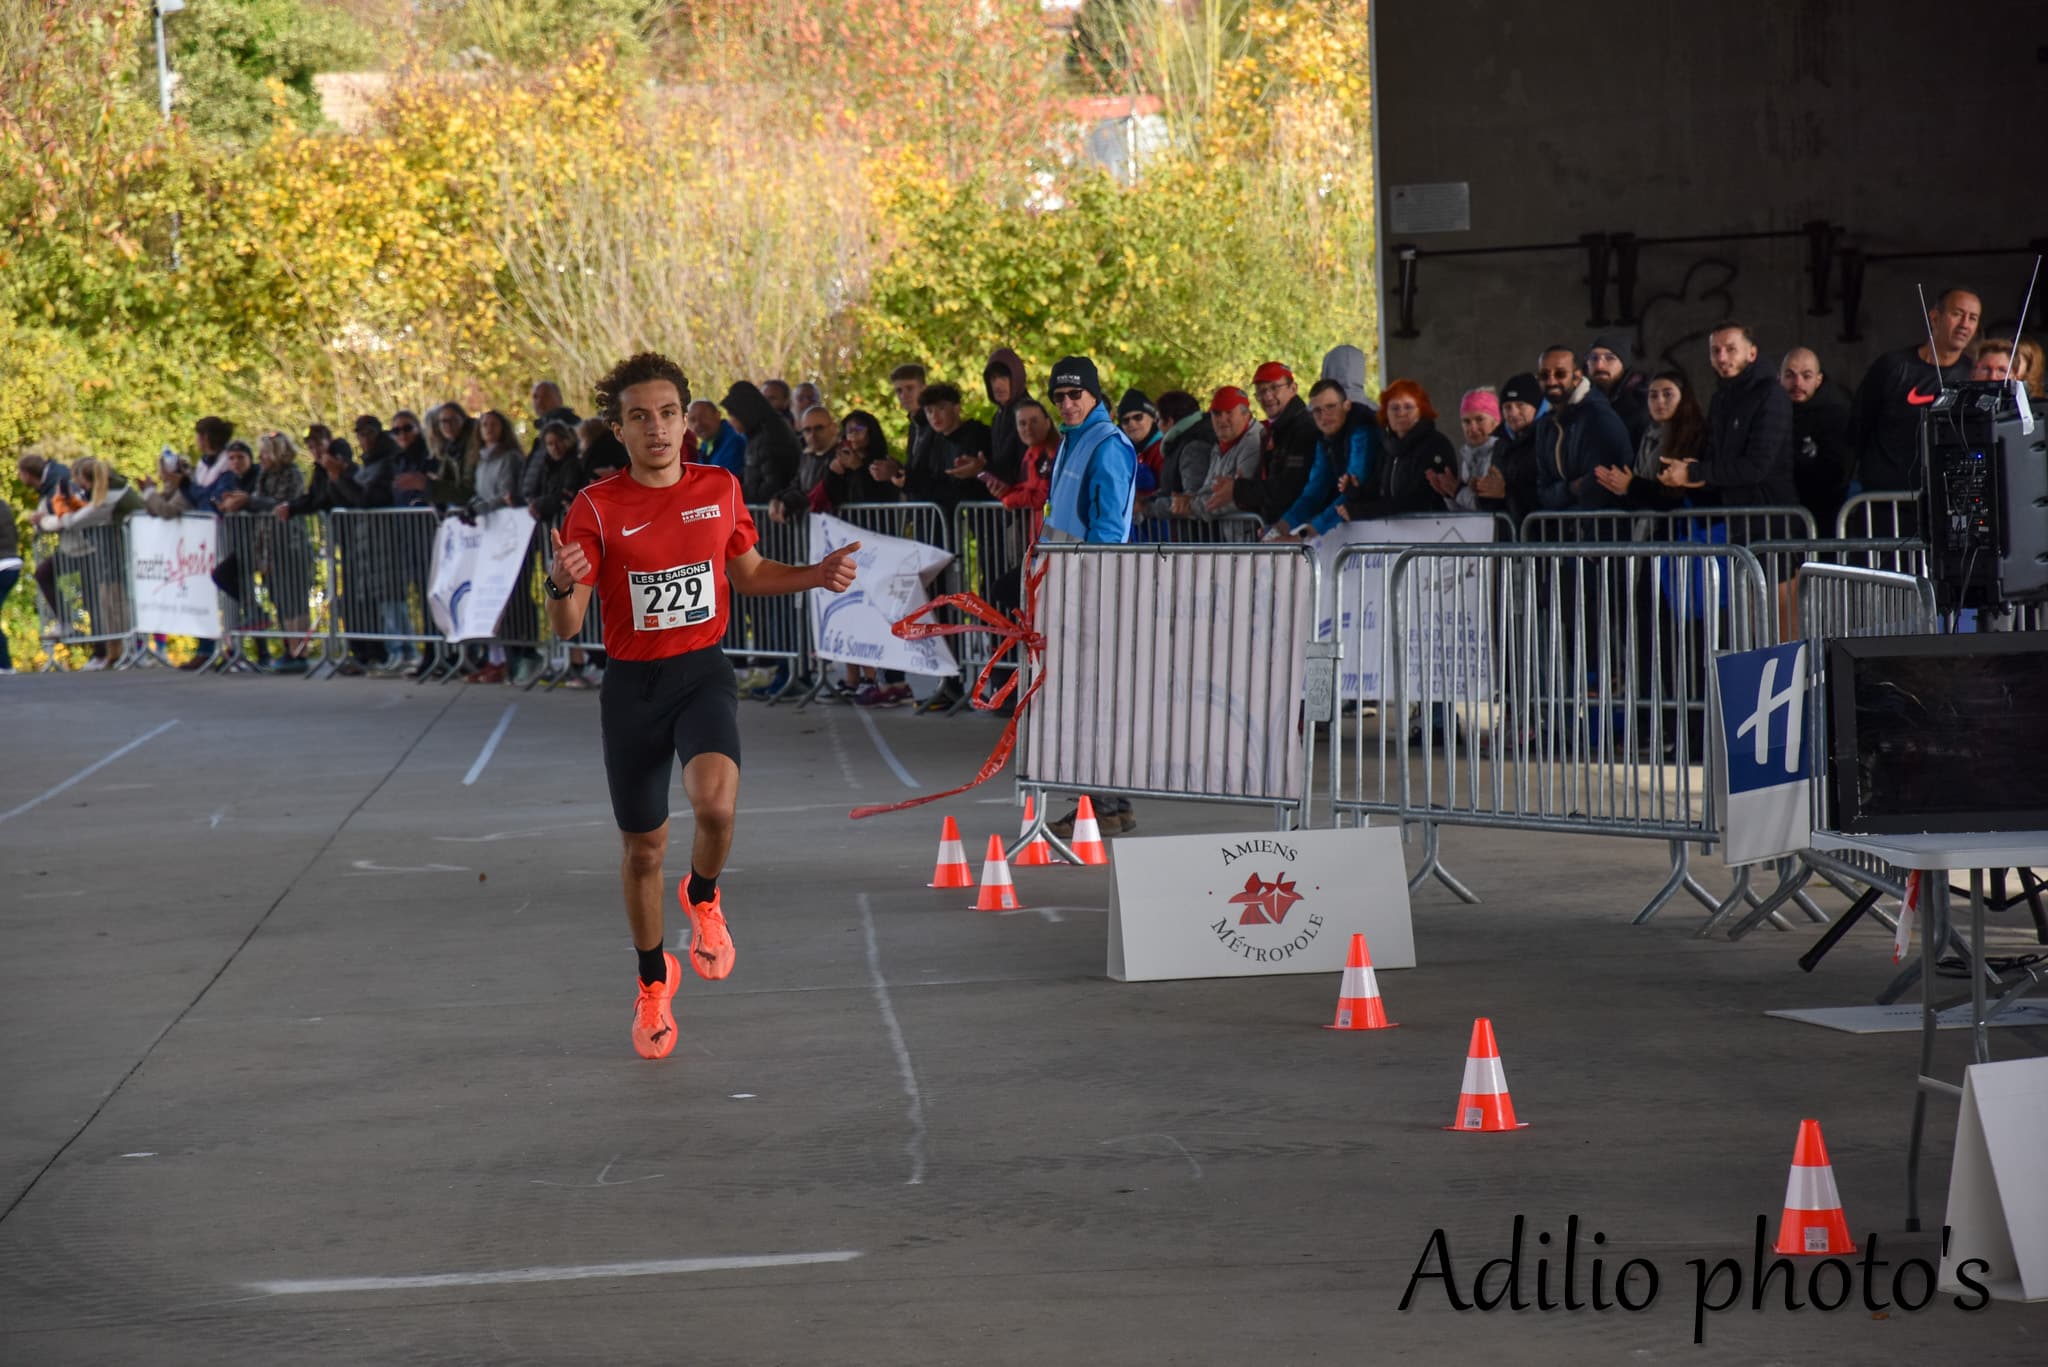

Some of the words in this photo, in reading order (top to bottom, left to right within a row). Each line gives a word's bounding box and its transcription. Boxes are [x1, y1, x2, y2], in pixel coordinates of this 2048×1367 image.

[635, 573, 655, 584] LES
[657, 572, 663, 582] 4
[665, 564, 706, 581] SAISONS
[643, 577, 702, 614] 229
[1220, 839, 1298, 866] AMIENS
[1210, 913, 1324, 962] MÉTROPOLE
